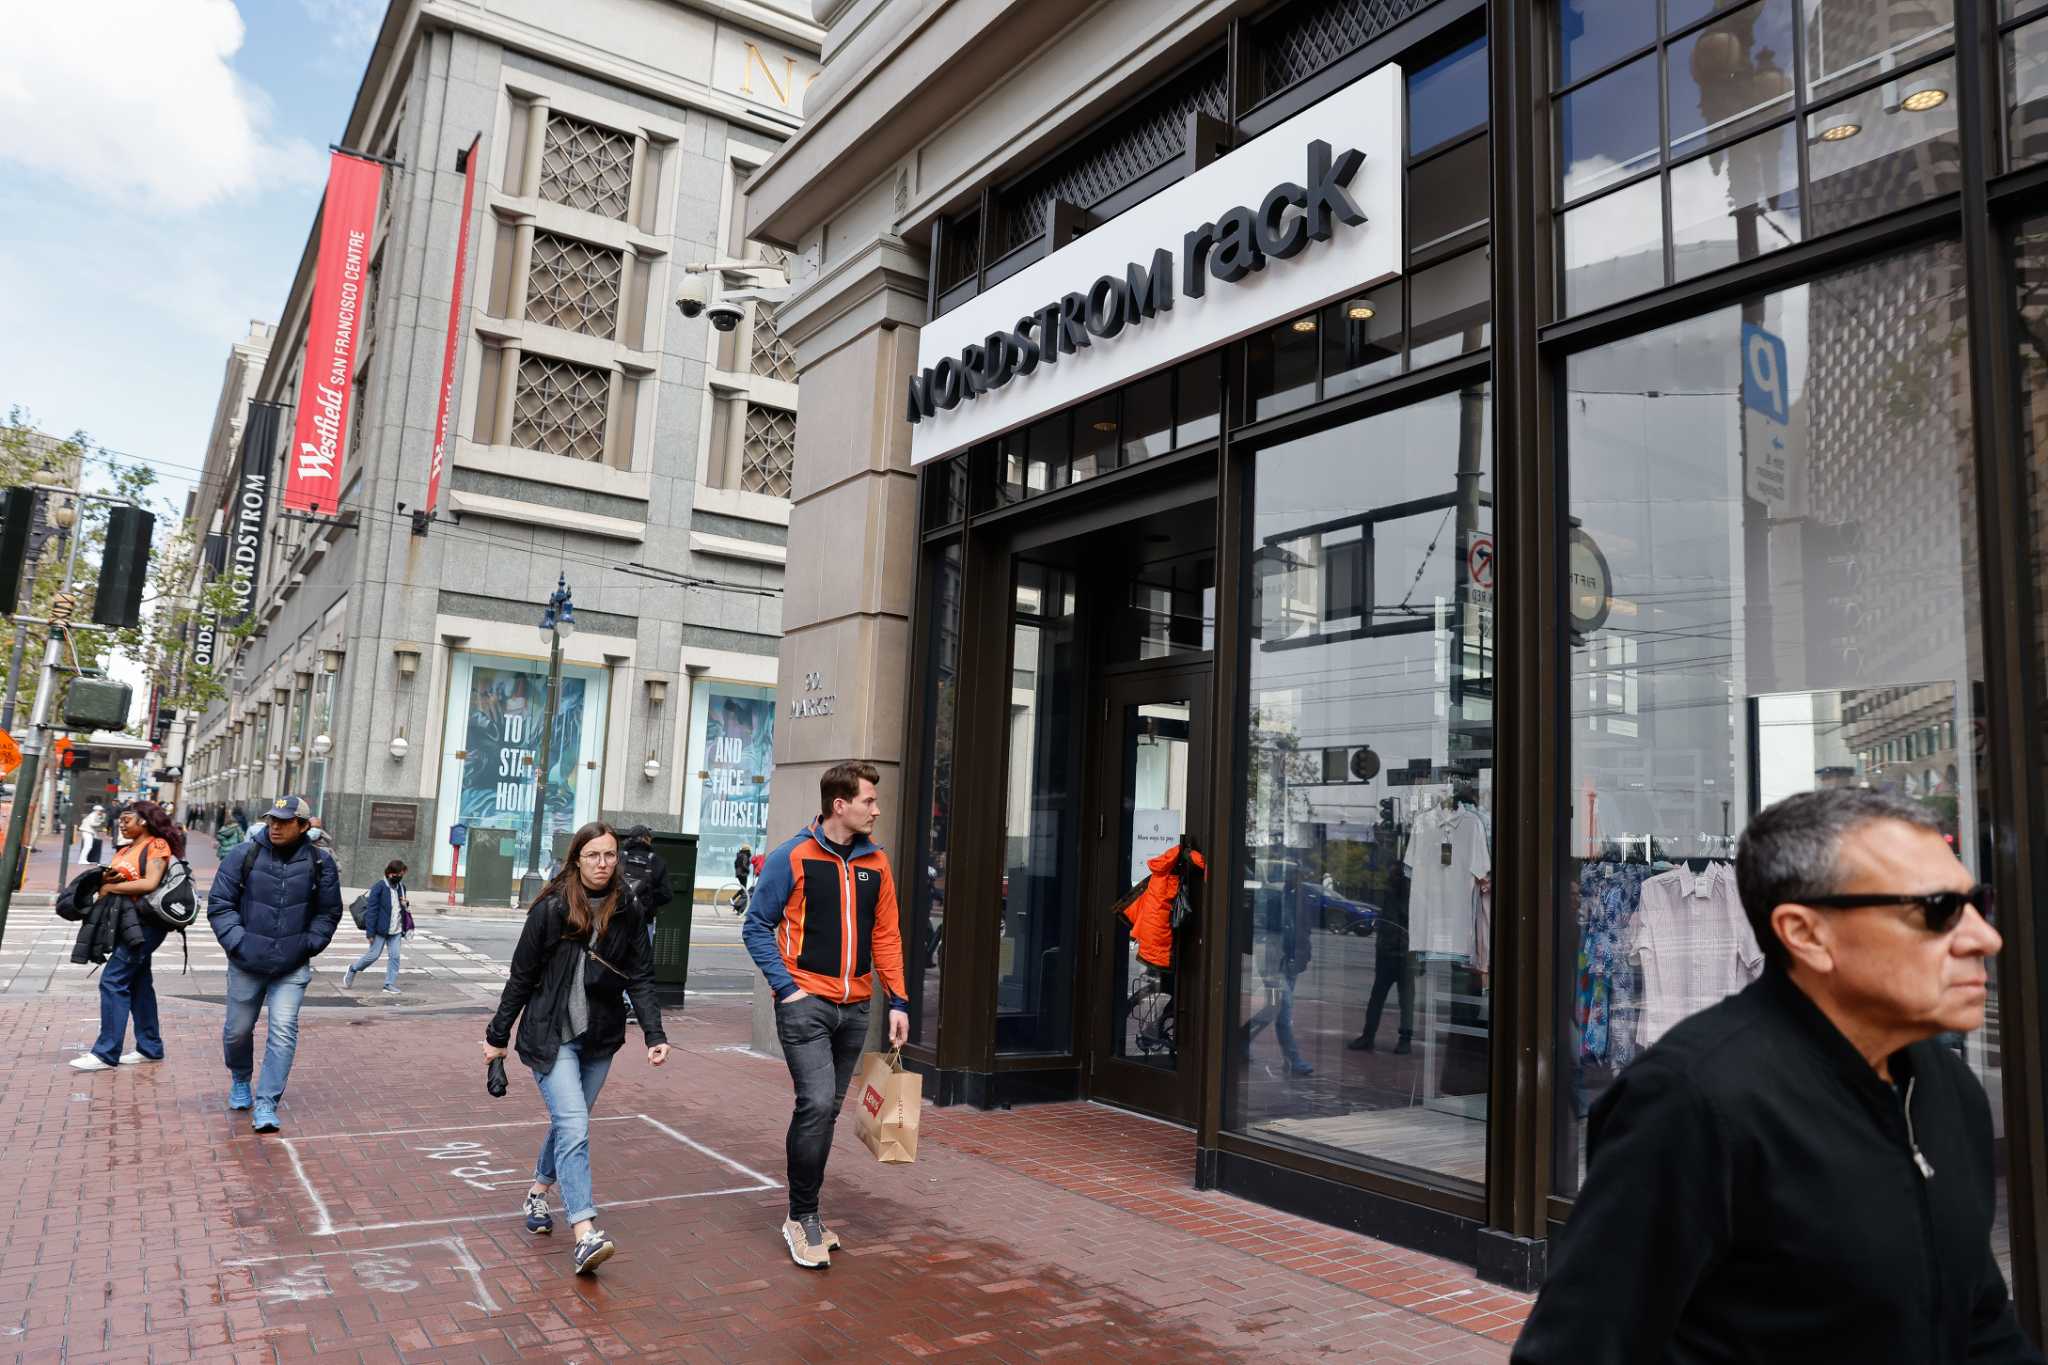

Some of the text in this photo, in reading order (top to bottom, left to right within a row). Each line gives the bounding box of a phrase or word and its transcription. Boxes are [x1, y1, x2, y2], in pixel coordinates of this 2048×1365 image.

[739, 41, 820, 107] N
[906, 139, 1368, 424] NORDSTROM rack
[297, 229, 365, 481] Westfield SAN FRANCISCO CENTRE
[231, 474, 266, 612] NORDSTROM
[503, 714, 523, 743] TO
[499, 748, 537, 779] STAY
[714, 736, 743, 763] AND
[711, 766, 744, 796] FACE
[495, 782, 537, 812] HOM
[710, 799, 769, 829] OURSELV
